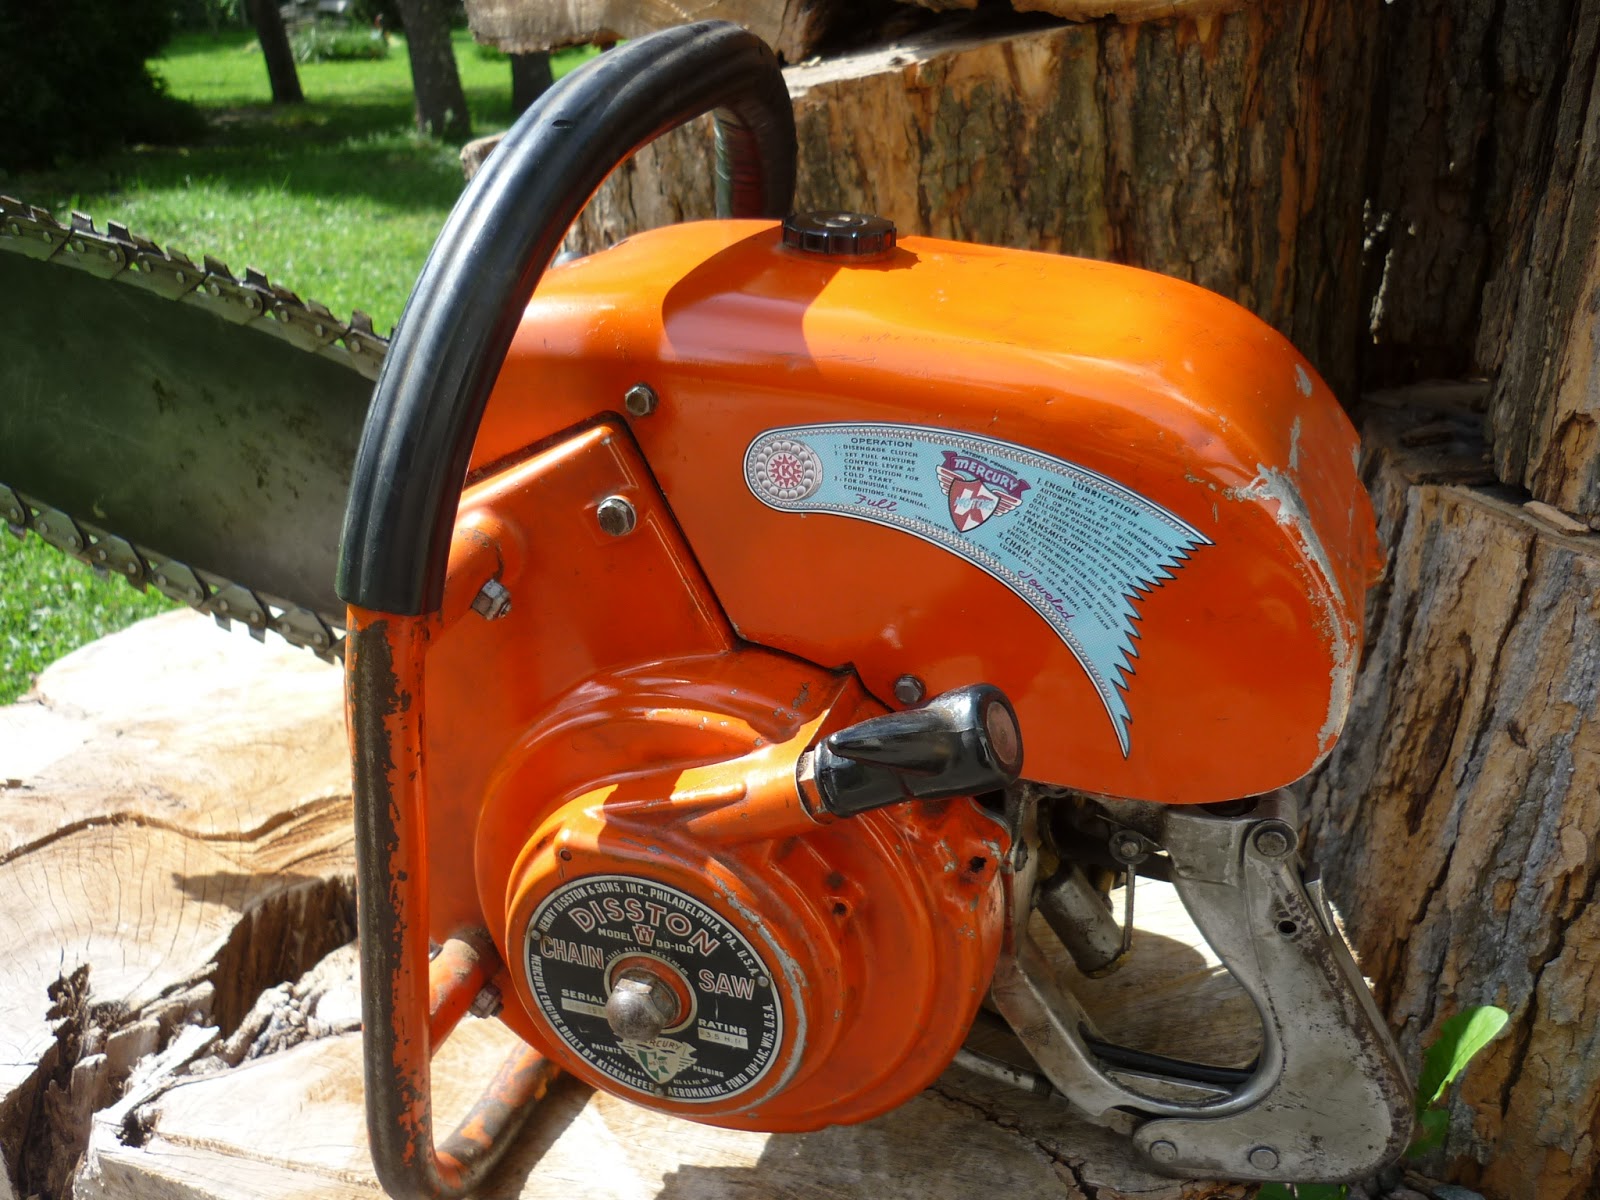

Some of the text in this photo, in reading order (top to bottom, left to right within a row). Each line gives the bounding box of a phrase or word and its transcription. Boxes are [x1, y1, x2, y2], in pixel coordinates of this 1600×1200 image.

[843, 444, 886, 453] DISENGAGE
[891, 449, 918, 458] CLUTCH
[851, 438, 912, 448] OPERATION
[868, 468, 901, 477] POSITION
[882, 456, 915, 465] MIXTURE
[954, 458, 1019, 490] MERCURY
[843, 485, 884, 496] CONDITIONS
[855, 493, 897, 511] Full
[859, 480, 888, 489] UNUSUAL
[892, 486, 923, 497] STARTING
[1072, 481, 1139, 517] LUBRICATION
[1026, 510, 1040, 519] MAY
[1033, 498, 1059, 513] GALLON
[1040, 488, 1082, 508] AUTOMOTIVE
[1085, 508, 1097, 516] SAE
[1111, 522, 1121, 530] OIL
[1013, 525, 1029, 537] LEVEL
[1038, 541, 1053, 554] EVEN
[1054, 552, 1069, 565] WITH
[1029, 503, 1039, 511] OIL
[1126, 561, 1136, 570] OIL
[1111, 512, 1126, 521] PINT
[1139, 527, 1151, 536] ANY
[1153, 536, 1172, 552] GOOD
[1117, 534, 1132, 547] WITH
[1136, 548, 1148, 559] ONE
[1007, 529, 1030, 545] ENGINE
[1038, 550, 1066, 573] STANDING
[1074, 580, 1096, 600] NORMAL
[1027, 526, 1070, 556] TRANSMISSION
[1107, 585, 1116, 595] OIL
[1018, 571, 1075, 622] Jeweled
[1118, 581, 1126, 590] OIL
[1070, 587, 1079, 596] OIL
[1082, 598, 1092, 609] FOR
[1093, 612, 1110, 630] CHAIN
[538, 907, 557, 932] HENRY
[553, 888, 587, 911] DISSTON
[587, 885, 596, 895] &
[568, 897, 720, 957] DISSTON
[598, 928, 633, 941] MODEL
[540, 935, 755, 999] CHAIN SAW
[561, 989, 605, 1005] SERIAL
[531, 954, 547, 994] MERCURY
[540, 995, 564, 1026] ENGINE
[560, 1025, 585, 1051] BUILT
[582, 1048, 596, 1060] BY
[726, 1072, 748, 1090] FOND
[698, 1018, 747, 1035] RATING
[591, 1043, 724, 1078] PATENTS PENDING
